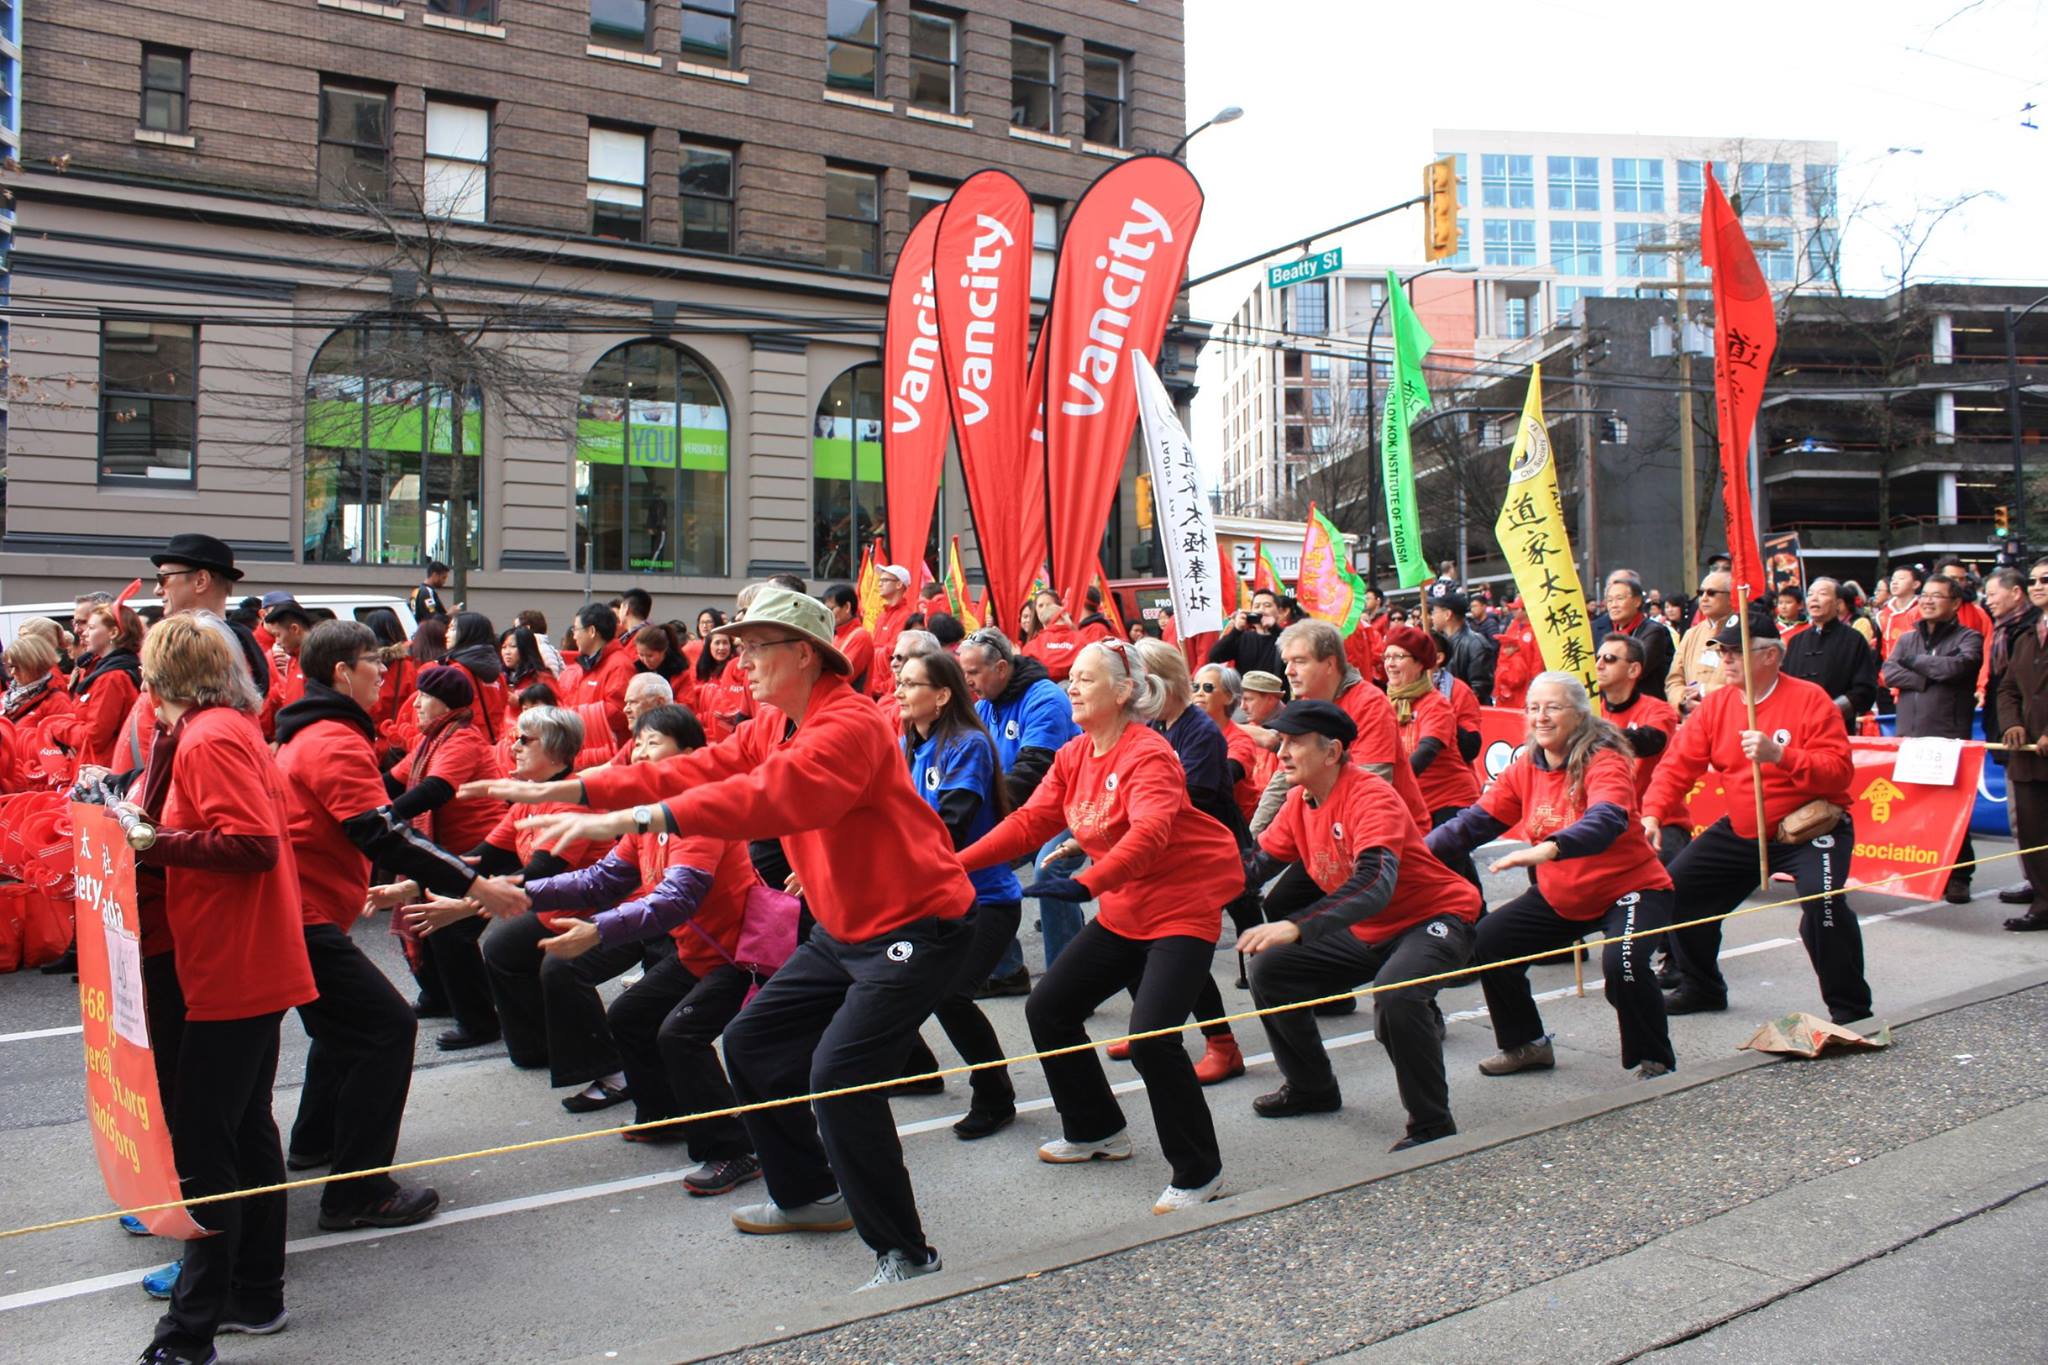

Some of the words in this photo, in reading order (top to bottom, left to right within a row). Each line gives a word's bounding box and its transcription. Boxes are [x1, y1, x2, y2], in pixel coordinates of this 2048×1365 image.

[1272, 260, 1318, 284] Beatty
[1322, 251, 1339, 270] St
[957, 213, 1014, 426] Vancity
[1061, 197, 1174, 416] Vancity
[892, 267, 939, 433] Vancit
[1386, 402, 1397, 422] LOY
[631, 428, 674, 463] YOU
[1387, 425, 1398, 448] KOK
[1387, 450, 1400, 506] INSTITUTE
[1391, 508, 1402, 521] OF
[1393, 524, 1409, 564] TAOISM
[80, 826, 93, 860] 太
[1852, 841, 1940, 865] sociation
